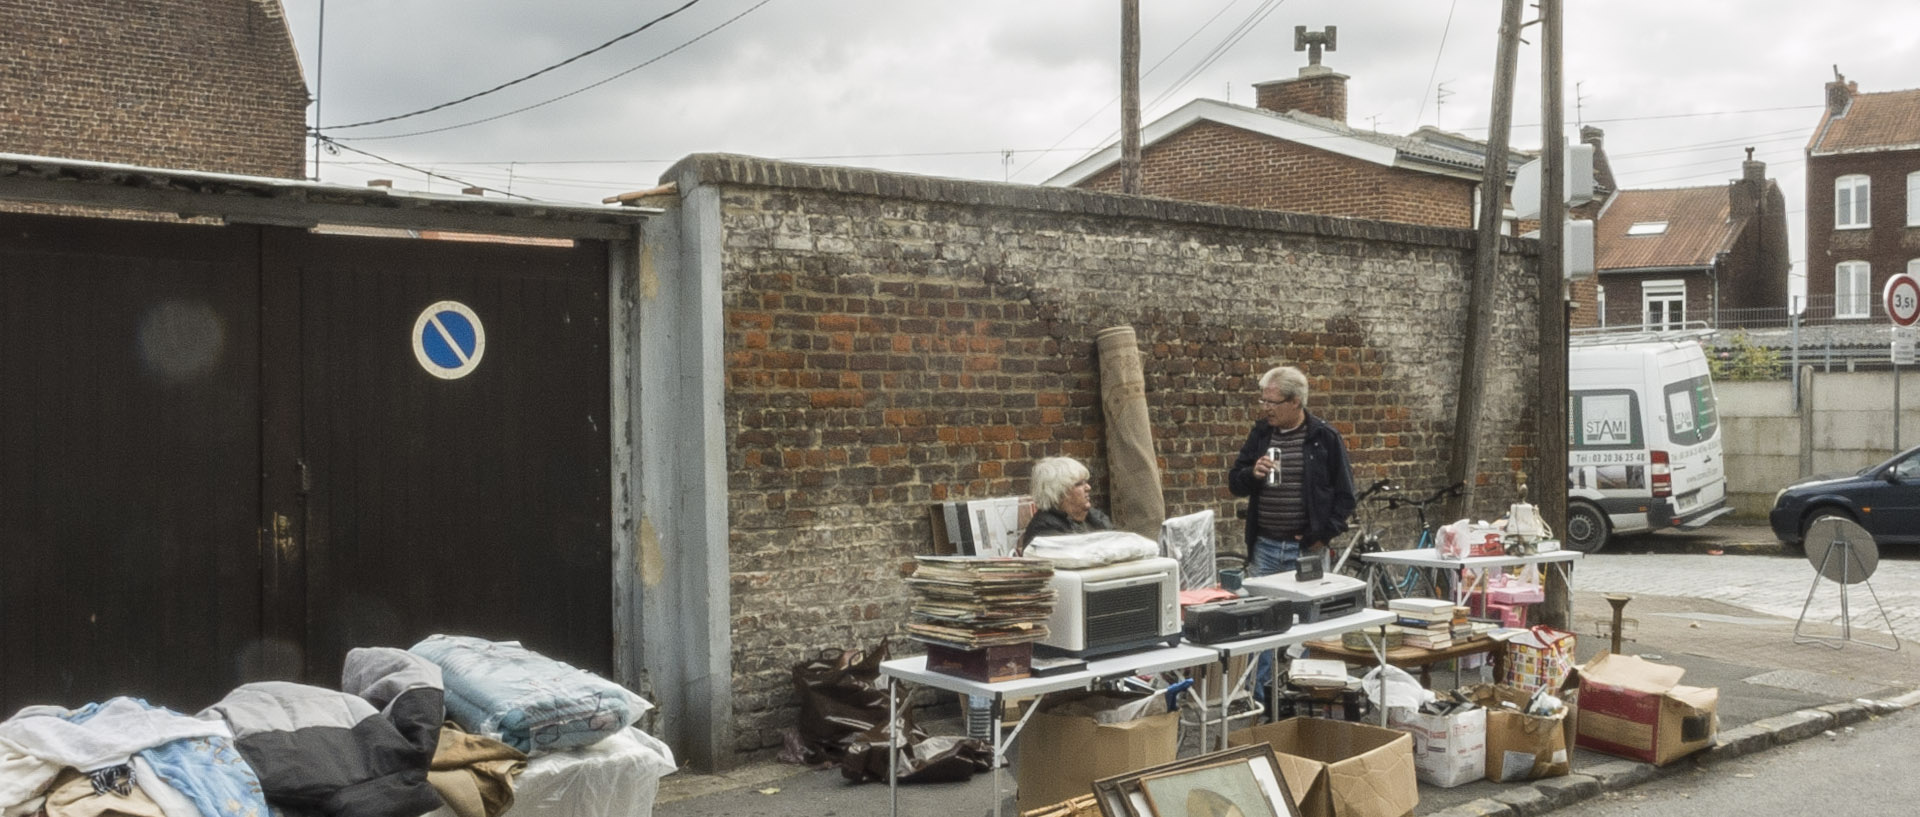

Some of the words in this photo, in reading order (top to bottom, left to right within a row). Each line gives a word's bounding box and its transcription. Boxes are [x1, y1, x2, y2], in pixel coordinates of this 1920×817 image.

[1586, 419, 1627, 440] STAMI
[1592, 454, 1601, 462] 03
[1604, 454, 1612, 462] 20
[1614, 454, 1623, 462] 36
[1636, 453, 1645, 462] 48
